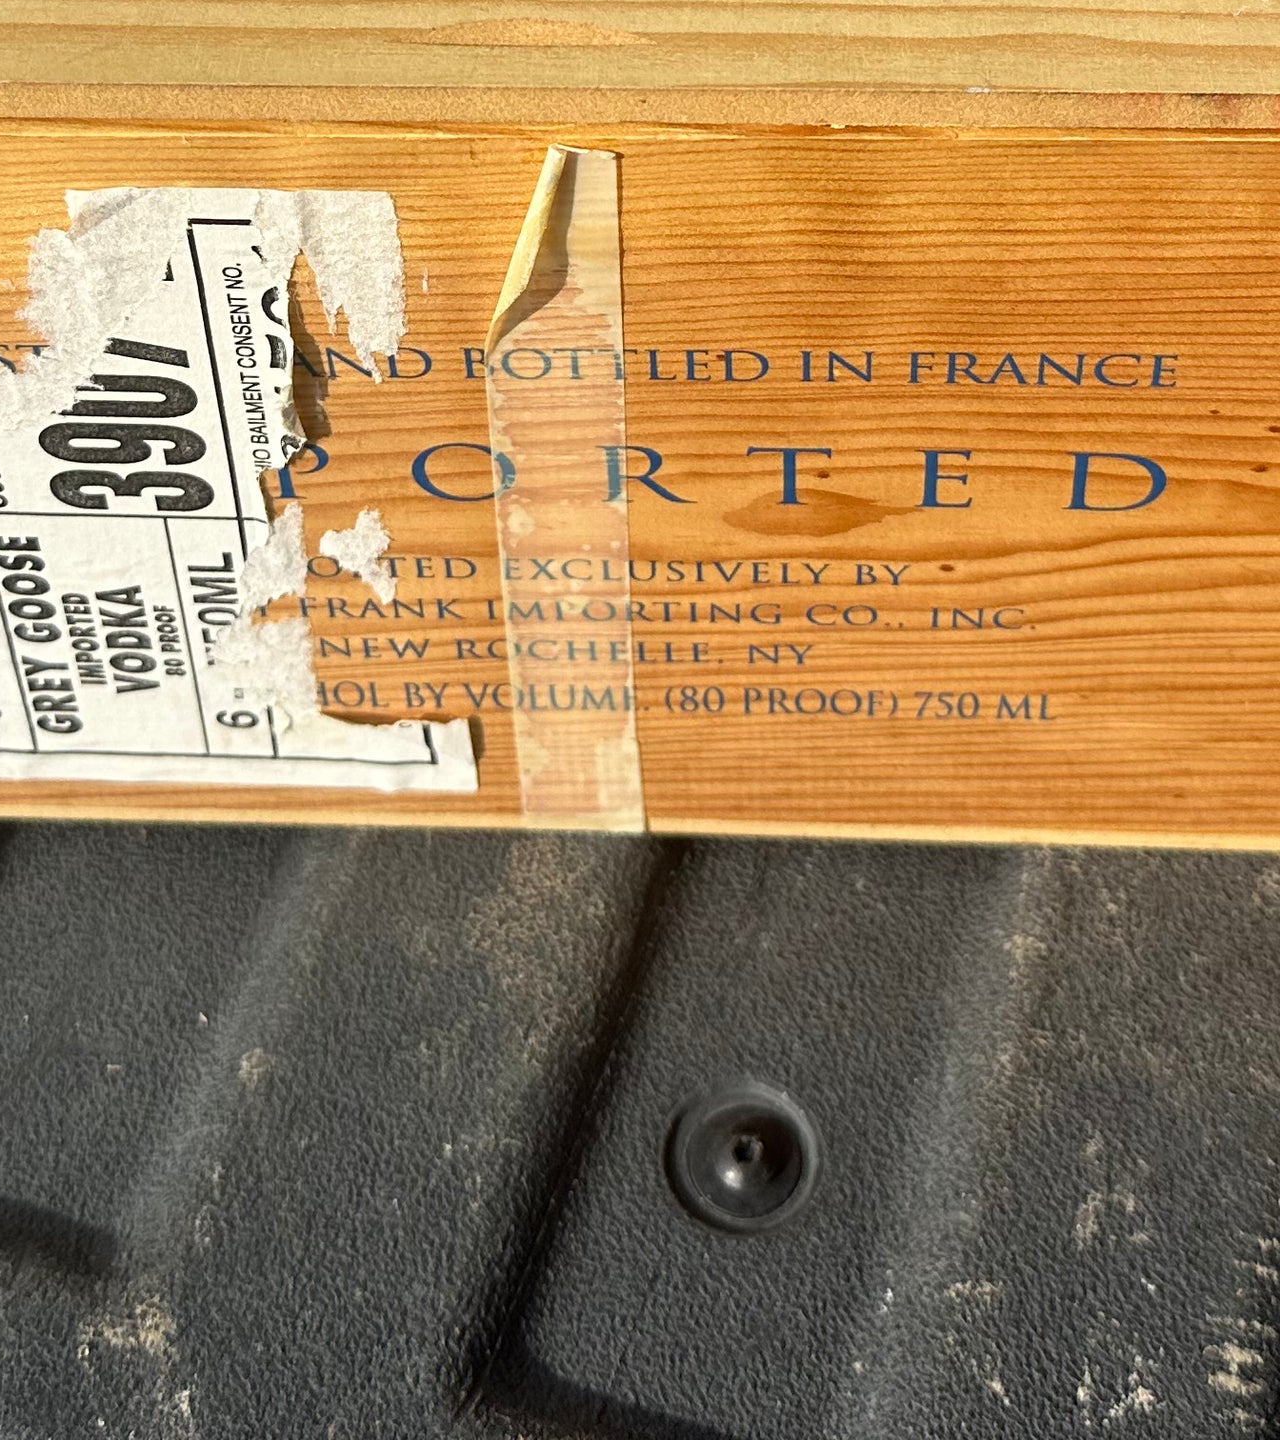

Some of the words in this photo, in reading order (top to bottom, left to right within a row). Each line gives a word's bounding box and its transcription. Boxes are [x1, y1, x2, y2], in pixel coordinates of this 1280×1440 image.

[222, 263, 245, 289] NO.
[227, 294, 256, 368] CONSENT
[461, 347, 769, 382] BOTTLED
[800, 350, 873, 383] IN
[907, 352, 1179, 388] FRANCE
[240, 372, 270, 445] BAILMENT
[275, 443, 1168, 512] PORTED
[503, 558, 831, 585] EXCLUSIVELY
[855, 564, 912, 586] BY
[153, 605, 181, 652] PROOF
[299, 597, 464, 619] FRANK
[487, 598, 781, 625] IMPORTING
[931, 607, 1037, 630] INC.
[61, 592, 108, 684] IMPORTED
[95, 585, 160, 693] VODKA
[319, 638, 429, 659] NEW
[748, 644, 815, 665] NY
[164, 658, 187, 676] 80
[22, 655, 83, 733] GREY
[405, 682, 450, 708] BY
[664, 685, 726, 715] (80
[743, 687, 899, 718] PROOF)
[915, 691, 980, 720] 750
[996, 694, 1057, 721] ML
[216, 710, 259, 728] 6
